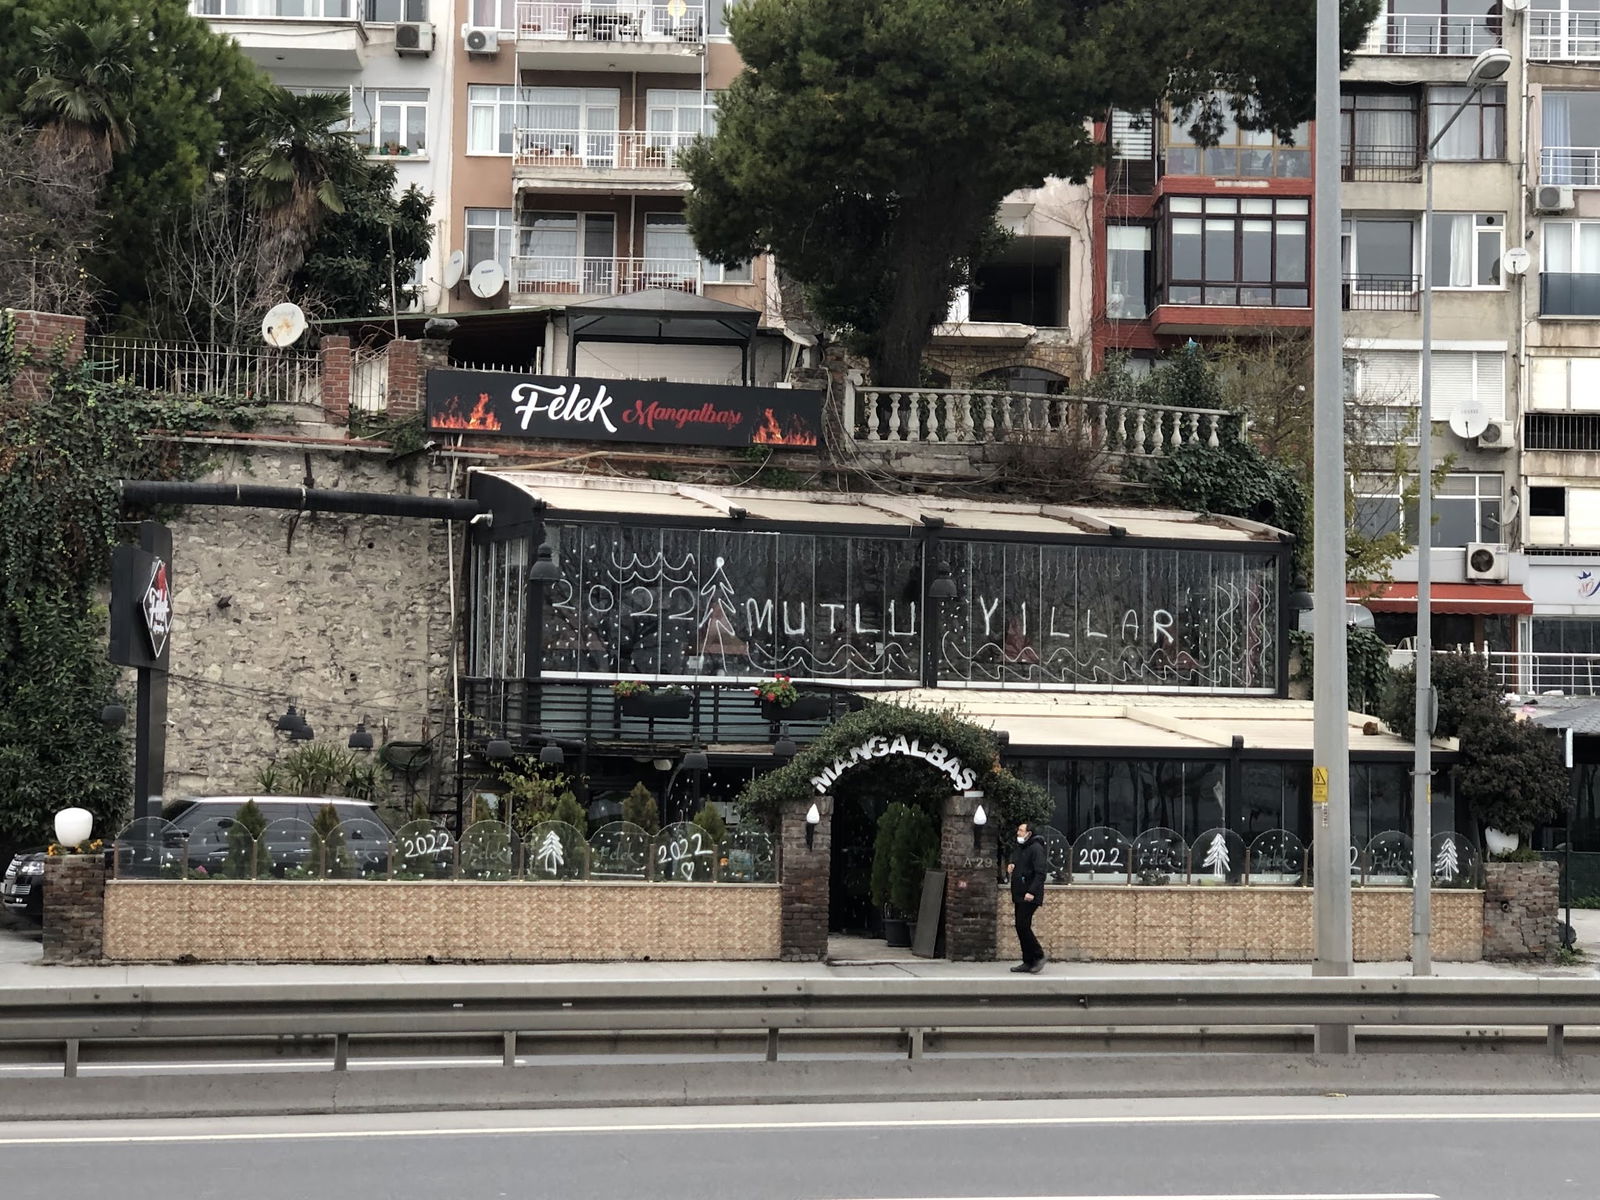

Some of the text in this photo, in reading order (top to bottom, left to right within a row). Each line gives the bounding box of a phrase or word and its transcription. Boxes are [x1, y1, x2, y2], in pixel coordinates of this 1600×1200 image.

[511, 383, 743, 433] Felek Mangalbaşı
[551, 578, 1173, 644] 2022 MUTLU YILLAR
[405, 832, 453, 858] 2022
[658, 832, 714, 864] 2022
[1079, 847, 1124, 868] 2022
